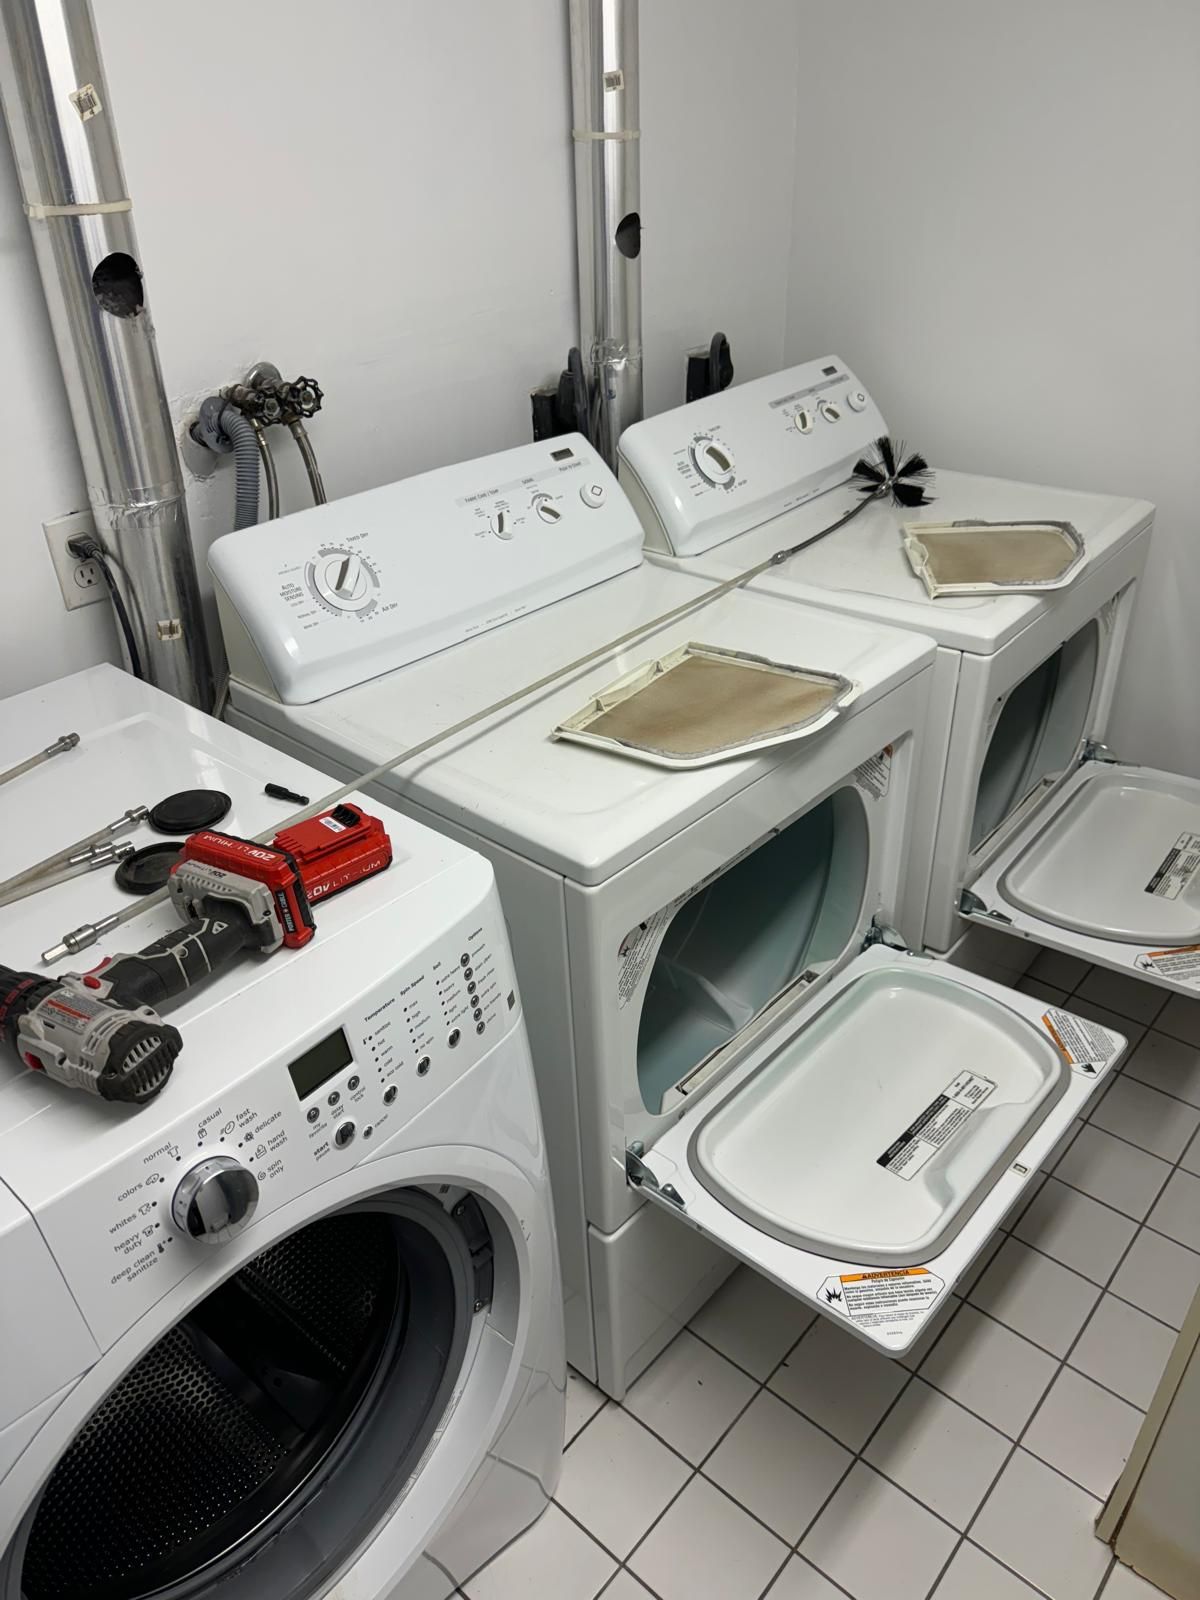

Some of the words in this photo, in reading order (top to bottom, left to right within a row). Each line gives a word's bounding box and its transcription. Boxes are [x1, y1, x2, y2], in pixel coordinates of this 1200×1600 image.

[249, 850, 276, 861] 20V
[400, 986, 410, 996] Spin
[411, 974, 425, 989] Speed
[364, 998, 396, 1022] Temperature
[198, 1107, 223, 1129] casual
[236, 1107, 252, 1122] fast
[238, 1111, 259, 1129] wash
[254, 1110, 282, 1134] delicate
[267, 1129, 286, 1146] hand
[269, 1136, 288, 1153] wash
[142, 1142, 172, 1165] normal
[313, 1141, 329, 1156] start
[267, 1158, 282, 1175] spin
[268, 1165, 285, 1180] only
[117, 1182, 143, 1202] colors
[108, 1213, 137, 1235] whites
[113, 1232, 140, 1253] heavy
[123, 1238, 143, 1256] duty
[110, 1265, 132, 1285] deep
[133, 1249, 156, 1269] clean
[127, 1256, 159, 1283] sanitize
